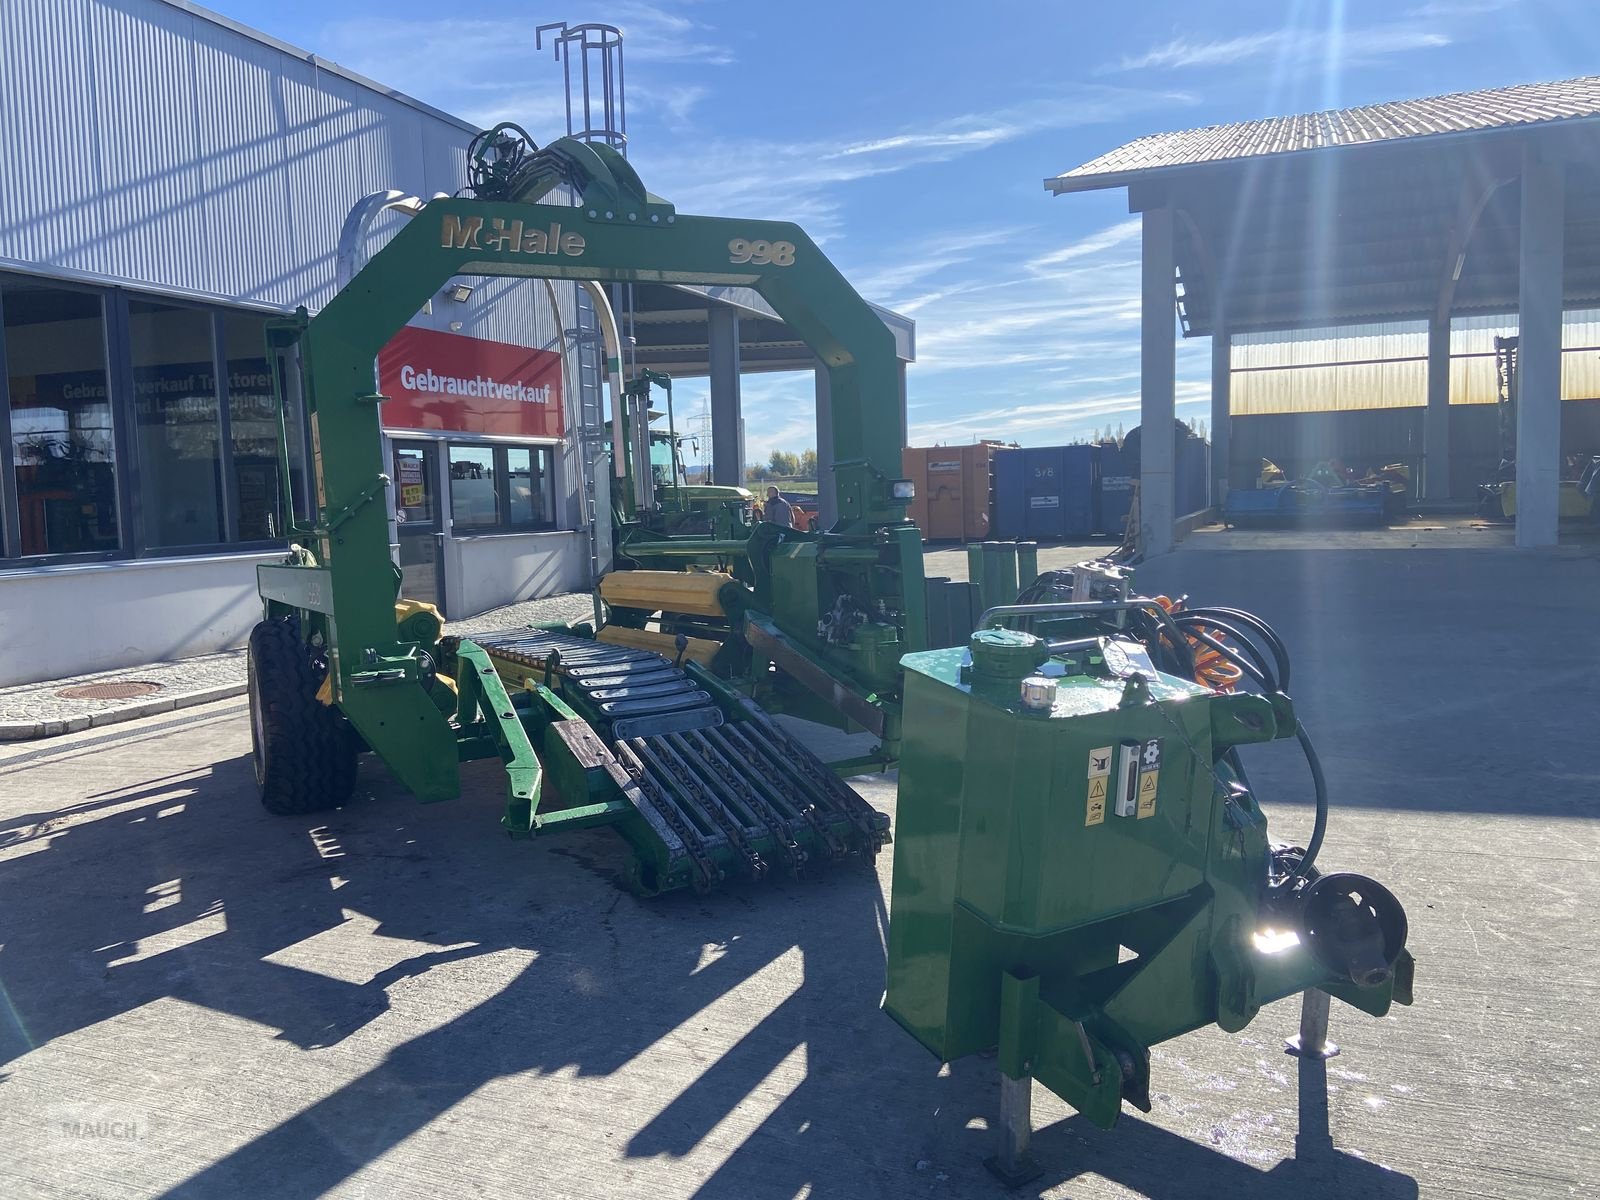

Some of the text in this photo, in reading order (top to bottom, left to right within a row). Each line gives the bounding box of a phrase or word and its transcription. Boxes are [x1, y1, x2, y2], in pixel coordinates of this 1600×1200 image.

[441, 213, 586, 256] McHale
[728, 238, 796, 267] 998
[63, 375, 195, 399] Gebraverkauf
[401, 364, 551, 404] Gebrauchtverkauf
